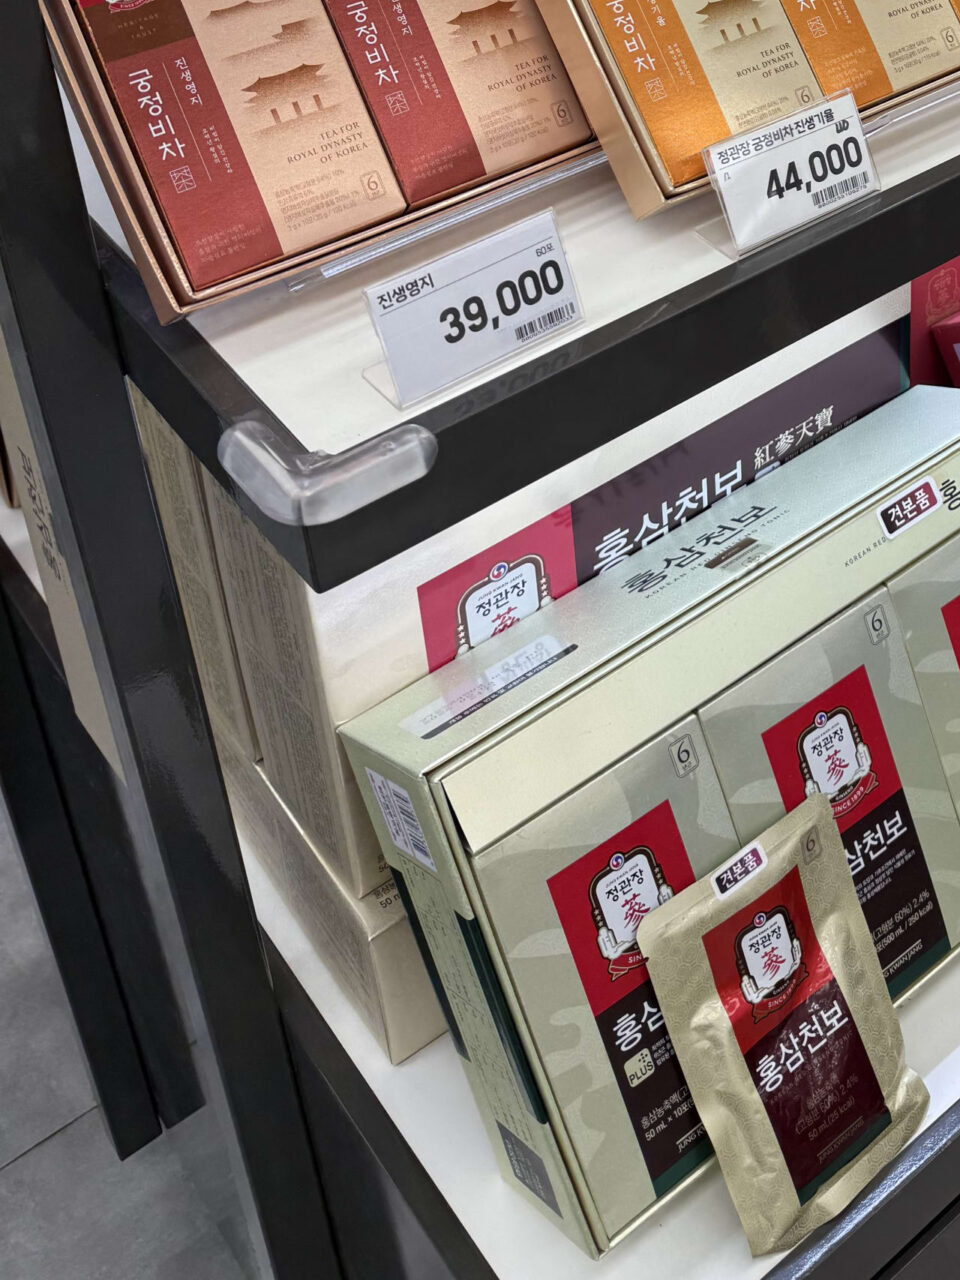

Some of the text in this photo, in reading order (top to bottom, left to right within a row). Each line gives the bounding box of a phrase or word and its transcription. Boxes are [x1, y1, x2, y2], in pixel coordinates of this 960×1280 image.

[346, 0, 400, 86] 궁정비차
[759, 42, 792, 58] TEA FOR
[173, 56, 204, 106] 진생영지
[736, 51, 795, 78] ROYAL DYNASTY
[762, 60, 800, 80] OF KOREA
[128, 68, 186, 161] 궁정비차
[320, 121, 360, 143] TEA FOR
[286, 131, 365, 165] ROYAL DYNASTY
[320, 142, 369, 164] OF KOREA
[717, 108, 835, 165] 정관장 궁정비차 진생기율
[766, 136, 863, 200] 44,000
[376, 273, 435, 310] 진생영지
[439, 259, 564, 344] 39,000
[594, 459, 748, 573] 홍삼천보
[886, 490, 932, 528] 견본품
[621, 505, 778, 594] 홍삼천보
[843, 535, 887, 568] KOREAN RED
[474, 579, 527, 618] 정관장
[871, 613, 883, 632] 6
[675, 742, 691, 762] 6
[811, 727, 845, 757] 정관장
[844, 810, 908, 877] 삼천보
[605, 867, 645, 902] 정관장
[718, 850, 759, 889] 견본품
[912, 890, 931, 909] 2.4%
[747, 923, 783, 954] 정관장
[612, 1001, 666, 1053] 홍삼
[755, 999, 849, 1093] 홍삼천보
[628, 1060, 654, 1085] PLUS
[645, 1131, 656, 1142] 50
